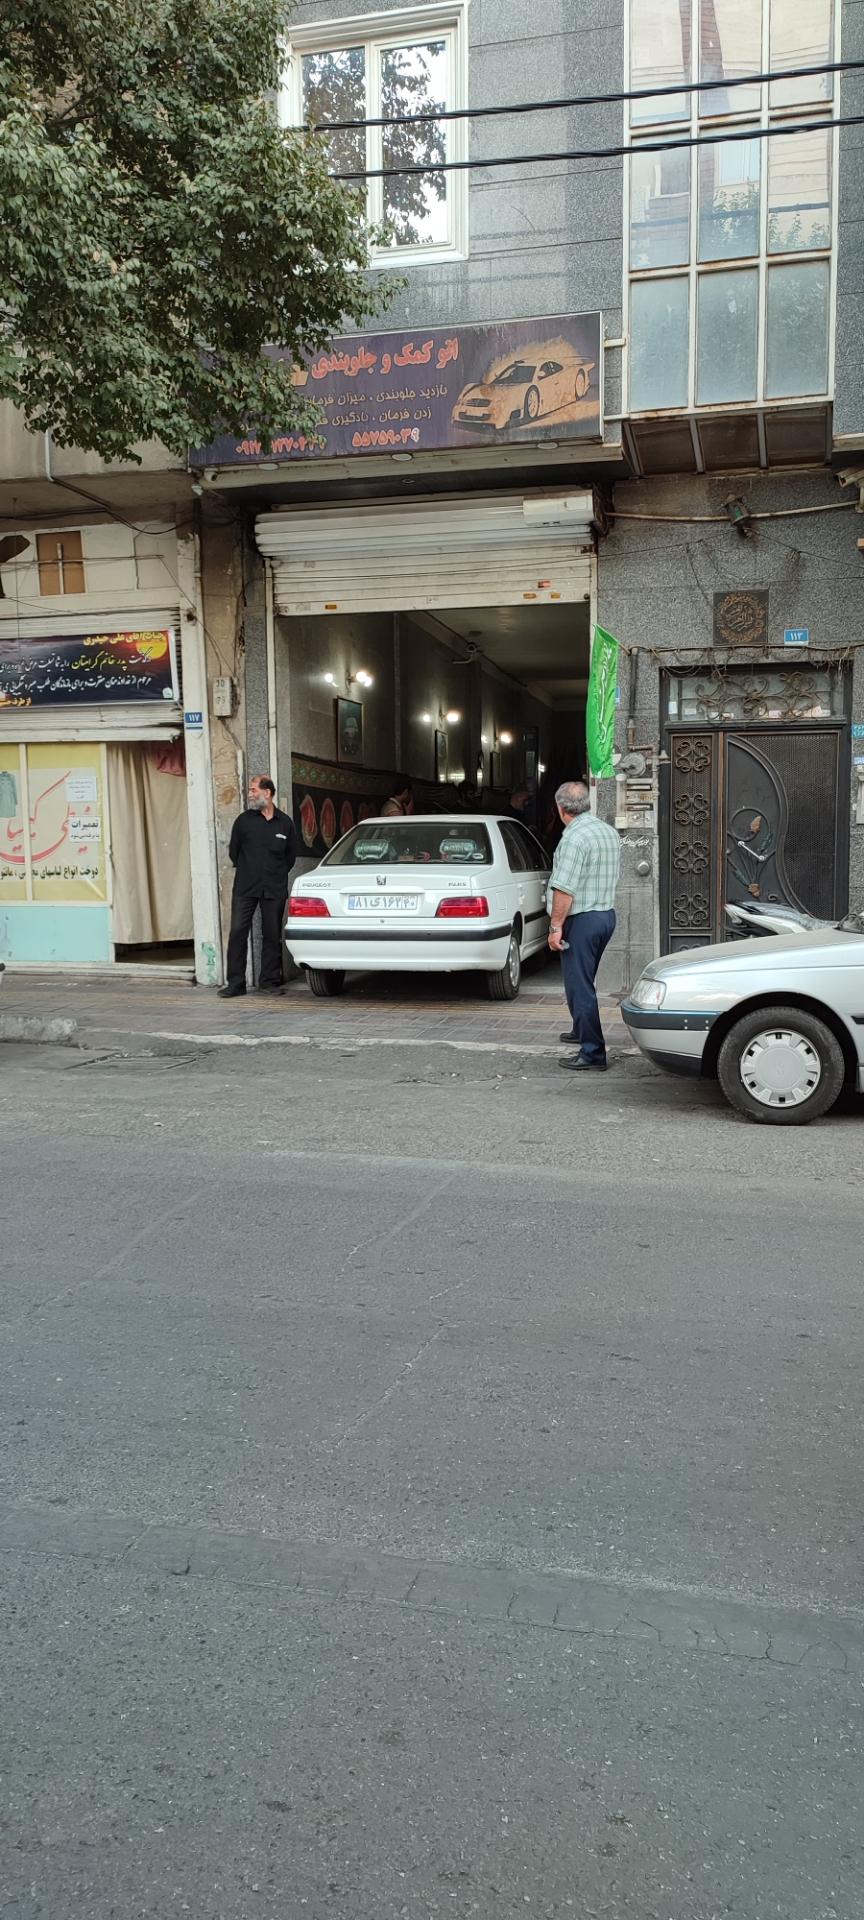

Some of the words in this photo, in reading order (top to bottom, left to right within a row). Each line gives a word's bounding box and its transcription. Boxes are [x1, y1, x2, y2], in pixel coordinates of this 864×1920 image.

[394, 340, 434, 367] کمک
[436, 337, 459, 369] اتو
[311, 346, 378, 379] جلوبندی
[380, 353, 391, 374] و
[337, 392, 366, 406] میزان
[376, 388, 416, 403] جلوبندی
[420, 384, 448, 400] بازدید
[379, 408, 410, 423] فرمان
[413, 406, 432, 420] زدن
[83, 635, 109, 646] حیدری
[109, 632, 125, 644] علی
[38, 652, 56, 672] تسلیت
[100, 652, 115, 671] خانم
[117, 658, 128, 671] پدر
[137, 676, 151, 689] مرحوم
[40, 865, 62, 880] لباسهای
[64, 865, 78, 880] انواع
[79, 866, 98, 880] دوخت
